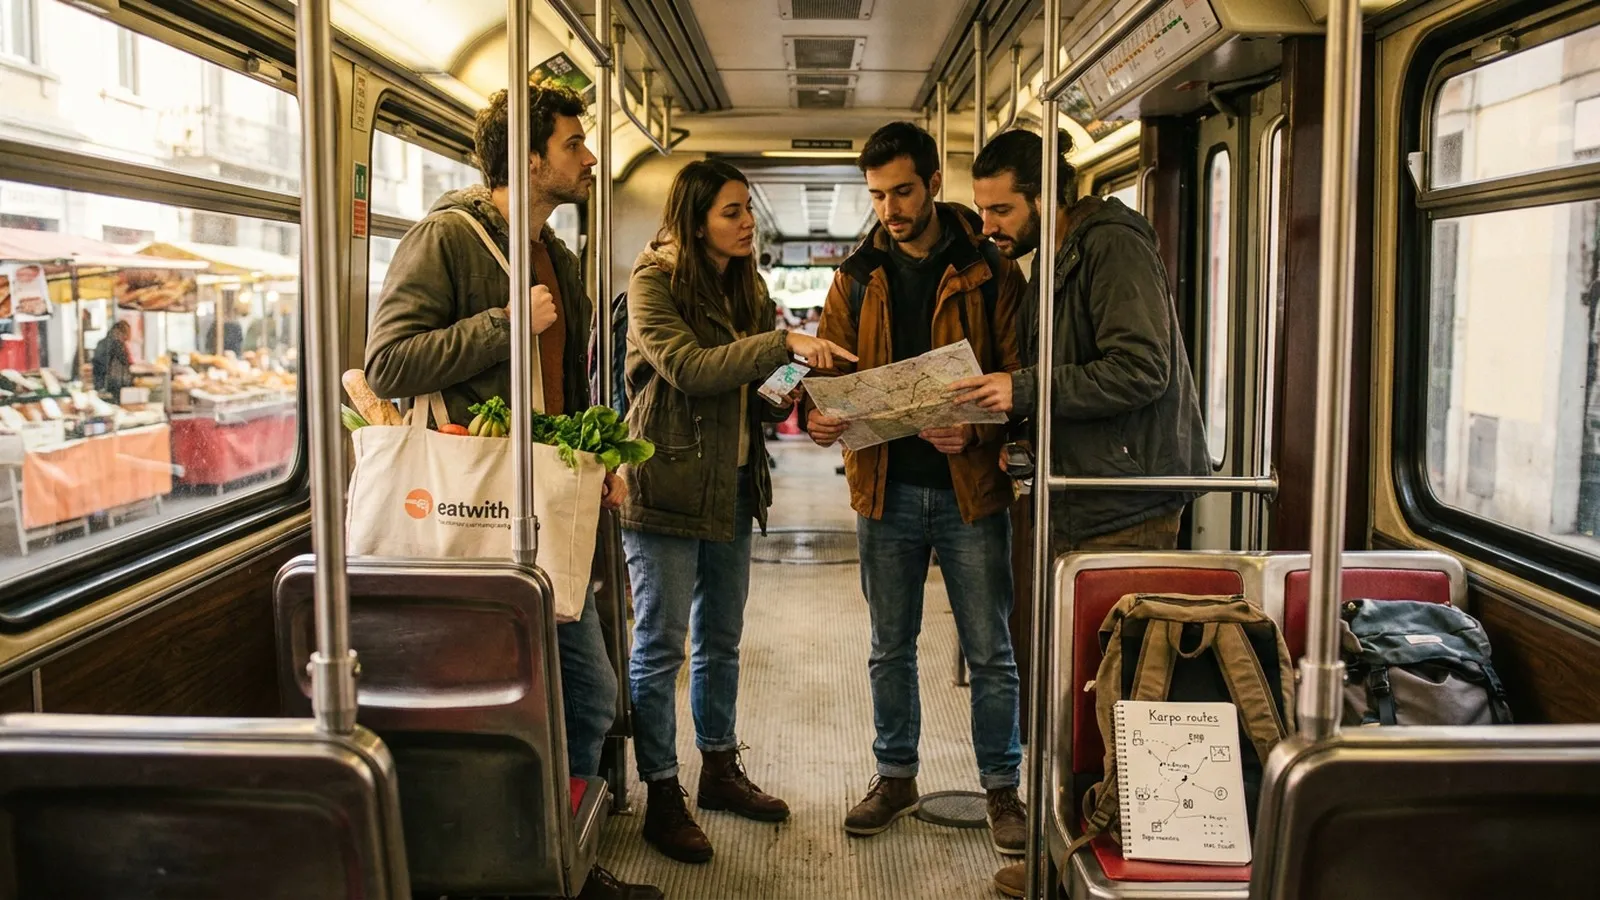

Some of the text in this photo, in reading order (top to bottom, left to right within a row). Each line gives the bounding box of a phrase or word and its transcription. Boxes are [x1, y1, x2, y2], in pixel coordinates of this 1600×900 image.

[437, 500, 509, 519] eatwith
[1149, 709, 1219, 726] Karpo routes
